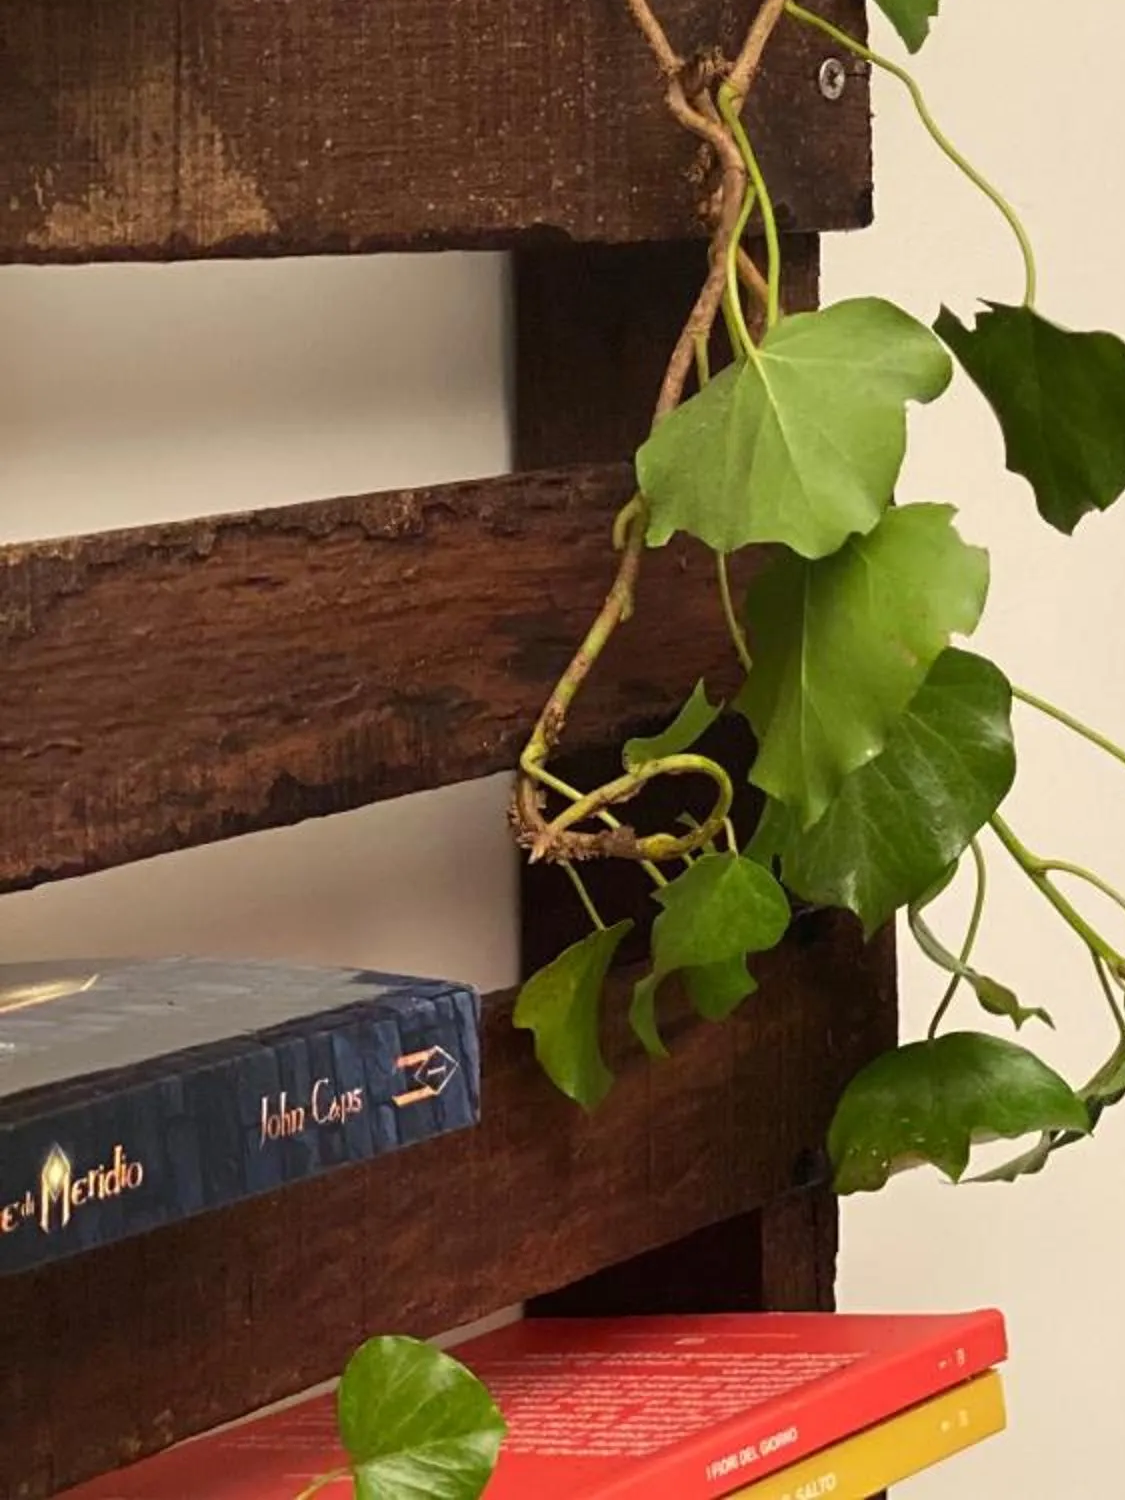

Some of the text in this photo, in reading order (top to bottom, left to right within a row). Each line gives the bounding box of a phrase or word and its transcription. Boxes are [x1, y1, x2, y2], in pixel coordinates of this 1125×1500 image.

[260, 1078, 364, 1151] John Caps
[40, 1141, 144, 1235] Meridio
[711, 1453, 739, 1481] FIORI
[738, 1445, 760, 1467] DEL
[759, 1425, 798, 1457] GIORNO
[795, 1471, 836, 1500] SALTO
